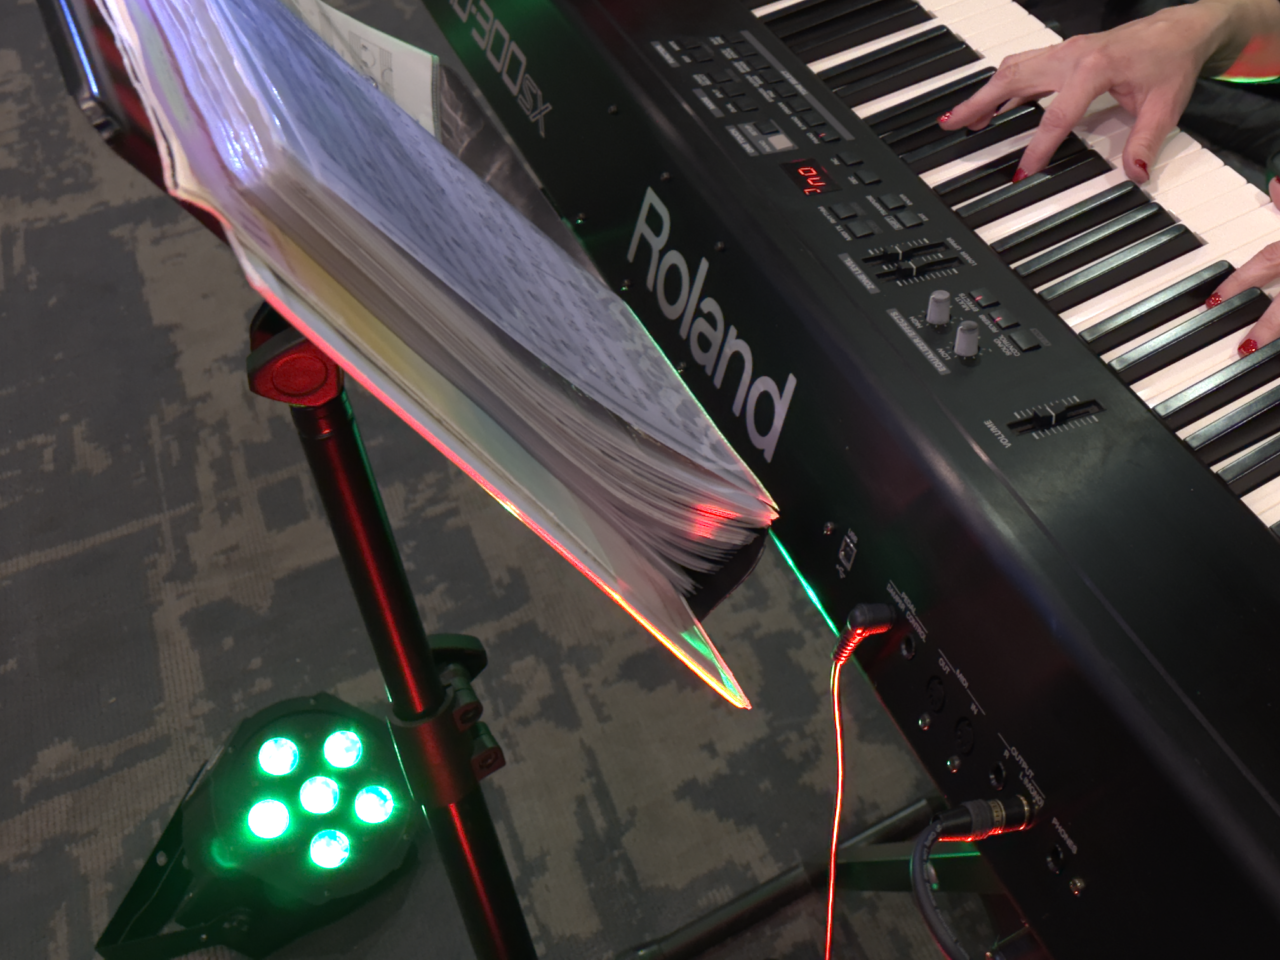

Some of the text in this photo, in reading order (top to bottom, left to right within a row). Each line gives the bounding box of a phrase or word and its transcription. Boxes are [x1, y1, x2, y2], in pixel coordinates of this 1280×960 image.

[945, 237, 977, 265] LOWER UPPER
[842, 257, 875, 289] ZONE LEVEL
[954, 297, 970, 309] MULTI
[958, 292, 979, 311] EFFECTS
[628, 186, 796, 462] Roland
[907, 315, 922, 328] HIGH
[977, 313, 999, 332] REVERB
[935, 347, 950, 359] LOW
[992, 338, 1012, 355] SOUND
[997, 334, 1020, 356] CONTROL
[983, 420, 1012, 449] VOLUME
[886, 583, 927, 643] DAMPER CONTROL
[899, 591, 916, 614] PEDAL
[938, 657, 950, 674] OUT
[954, 668, 969, 688] MIDI
[1009, 746, 1034, 778] OUTPUT
[1051, 816, 1077, 854] PHONES
